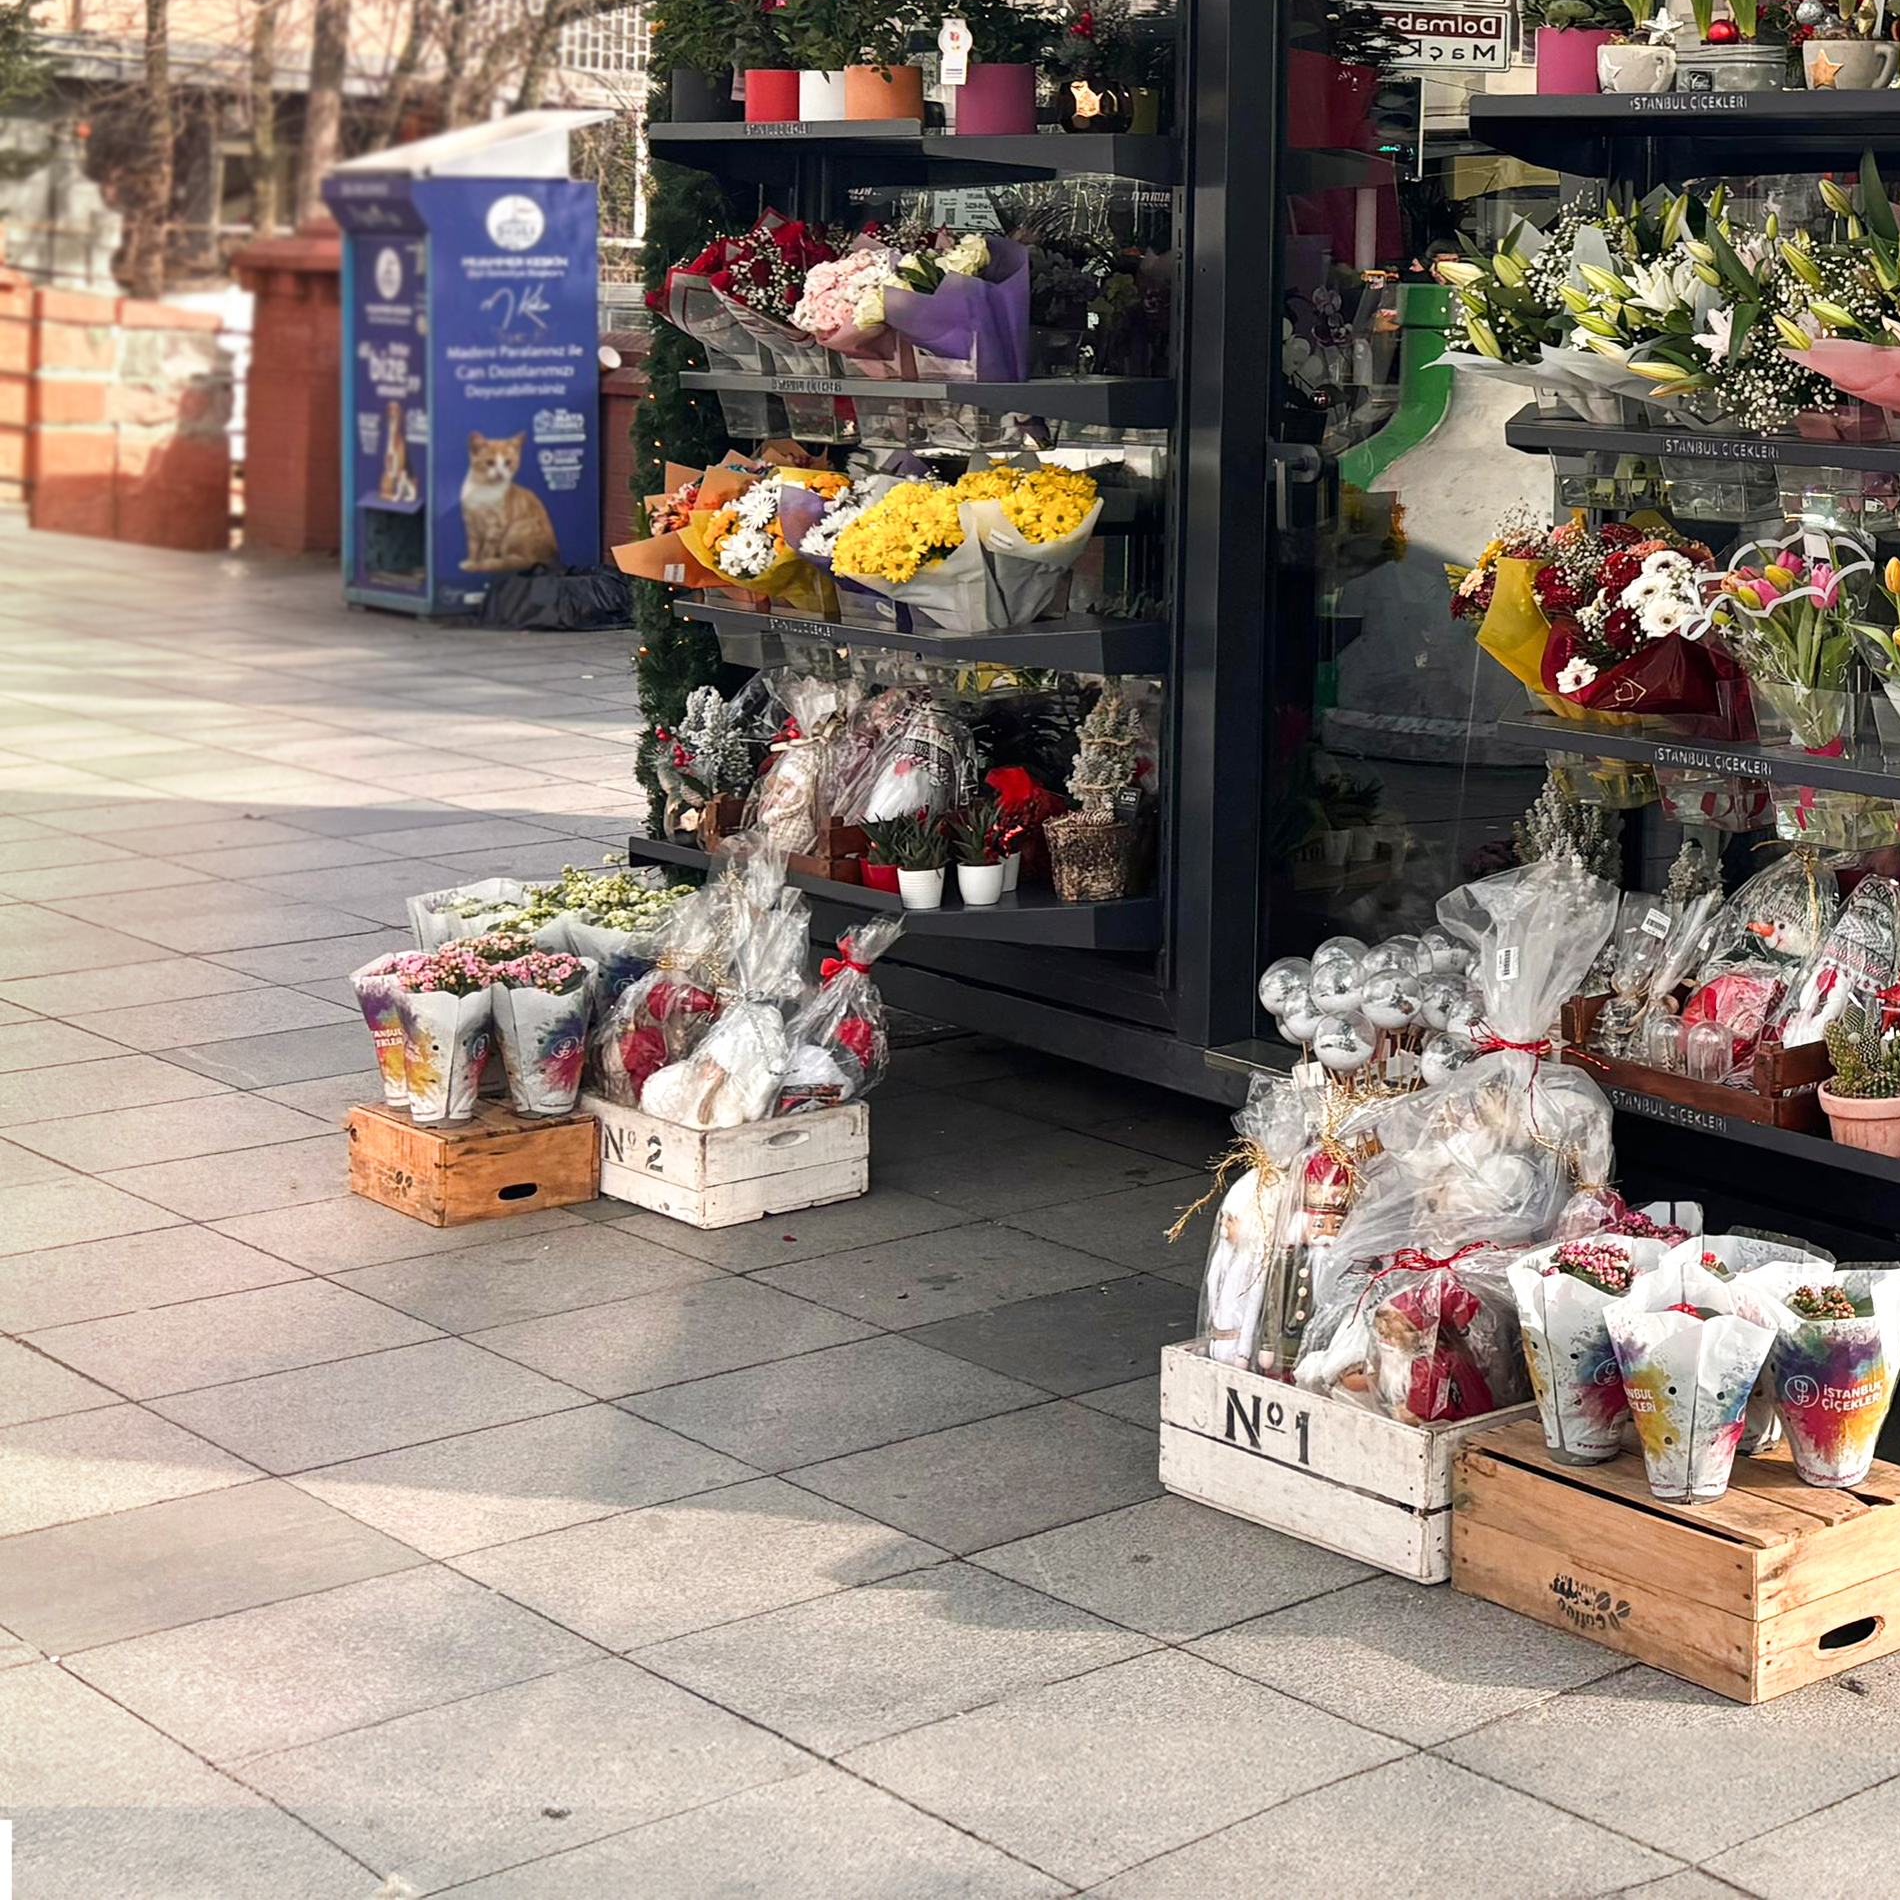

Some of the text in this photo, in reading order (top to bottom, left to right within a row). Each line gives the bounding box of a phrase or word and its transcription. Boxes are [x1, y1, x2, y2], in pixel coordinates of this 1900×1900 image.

[1630, 95, 1688, 111] İSTANBUL
[447, 345, 496, 359] Madeni
[456, 365, 485, 380] Can
[465, 383, 567, 399] Doyurabilirsiniz
[1611, 1090, 1666, 1117] STANBUL
[1823, 1380, 1883, 1400] İSTANBUL
[1821, 1390, 1883, 1413] ÇİÇEKLERİ
